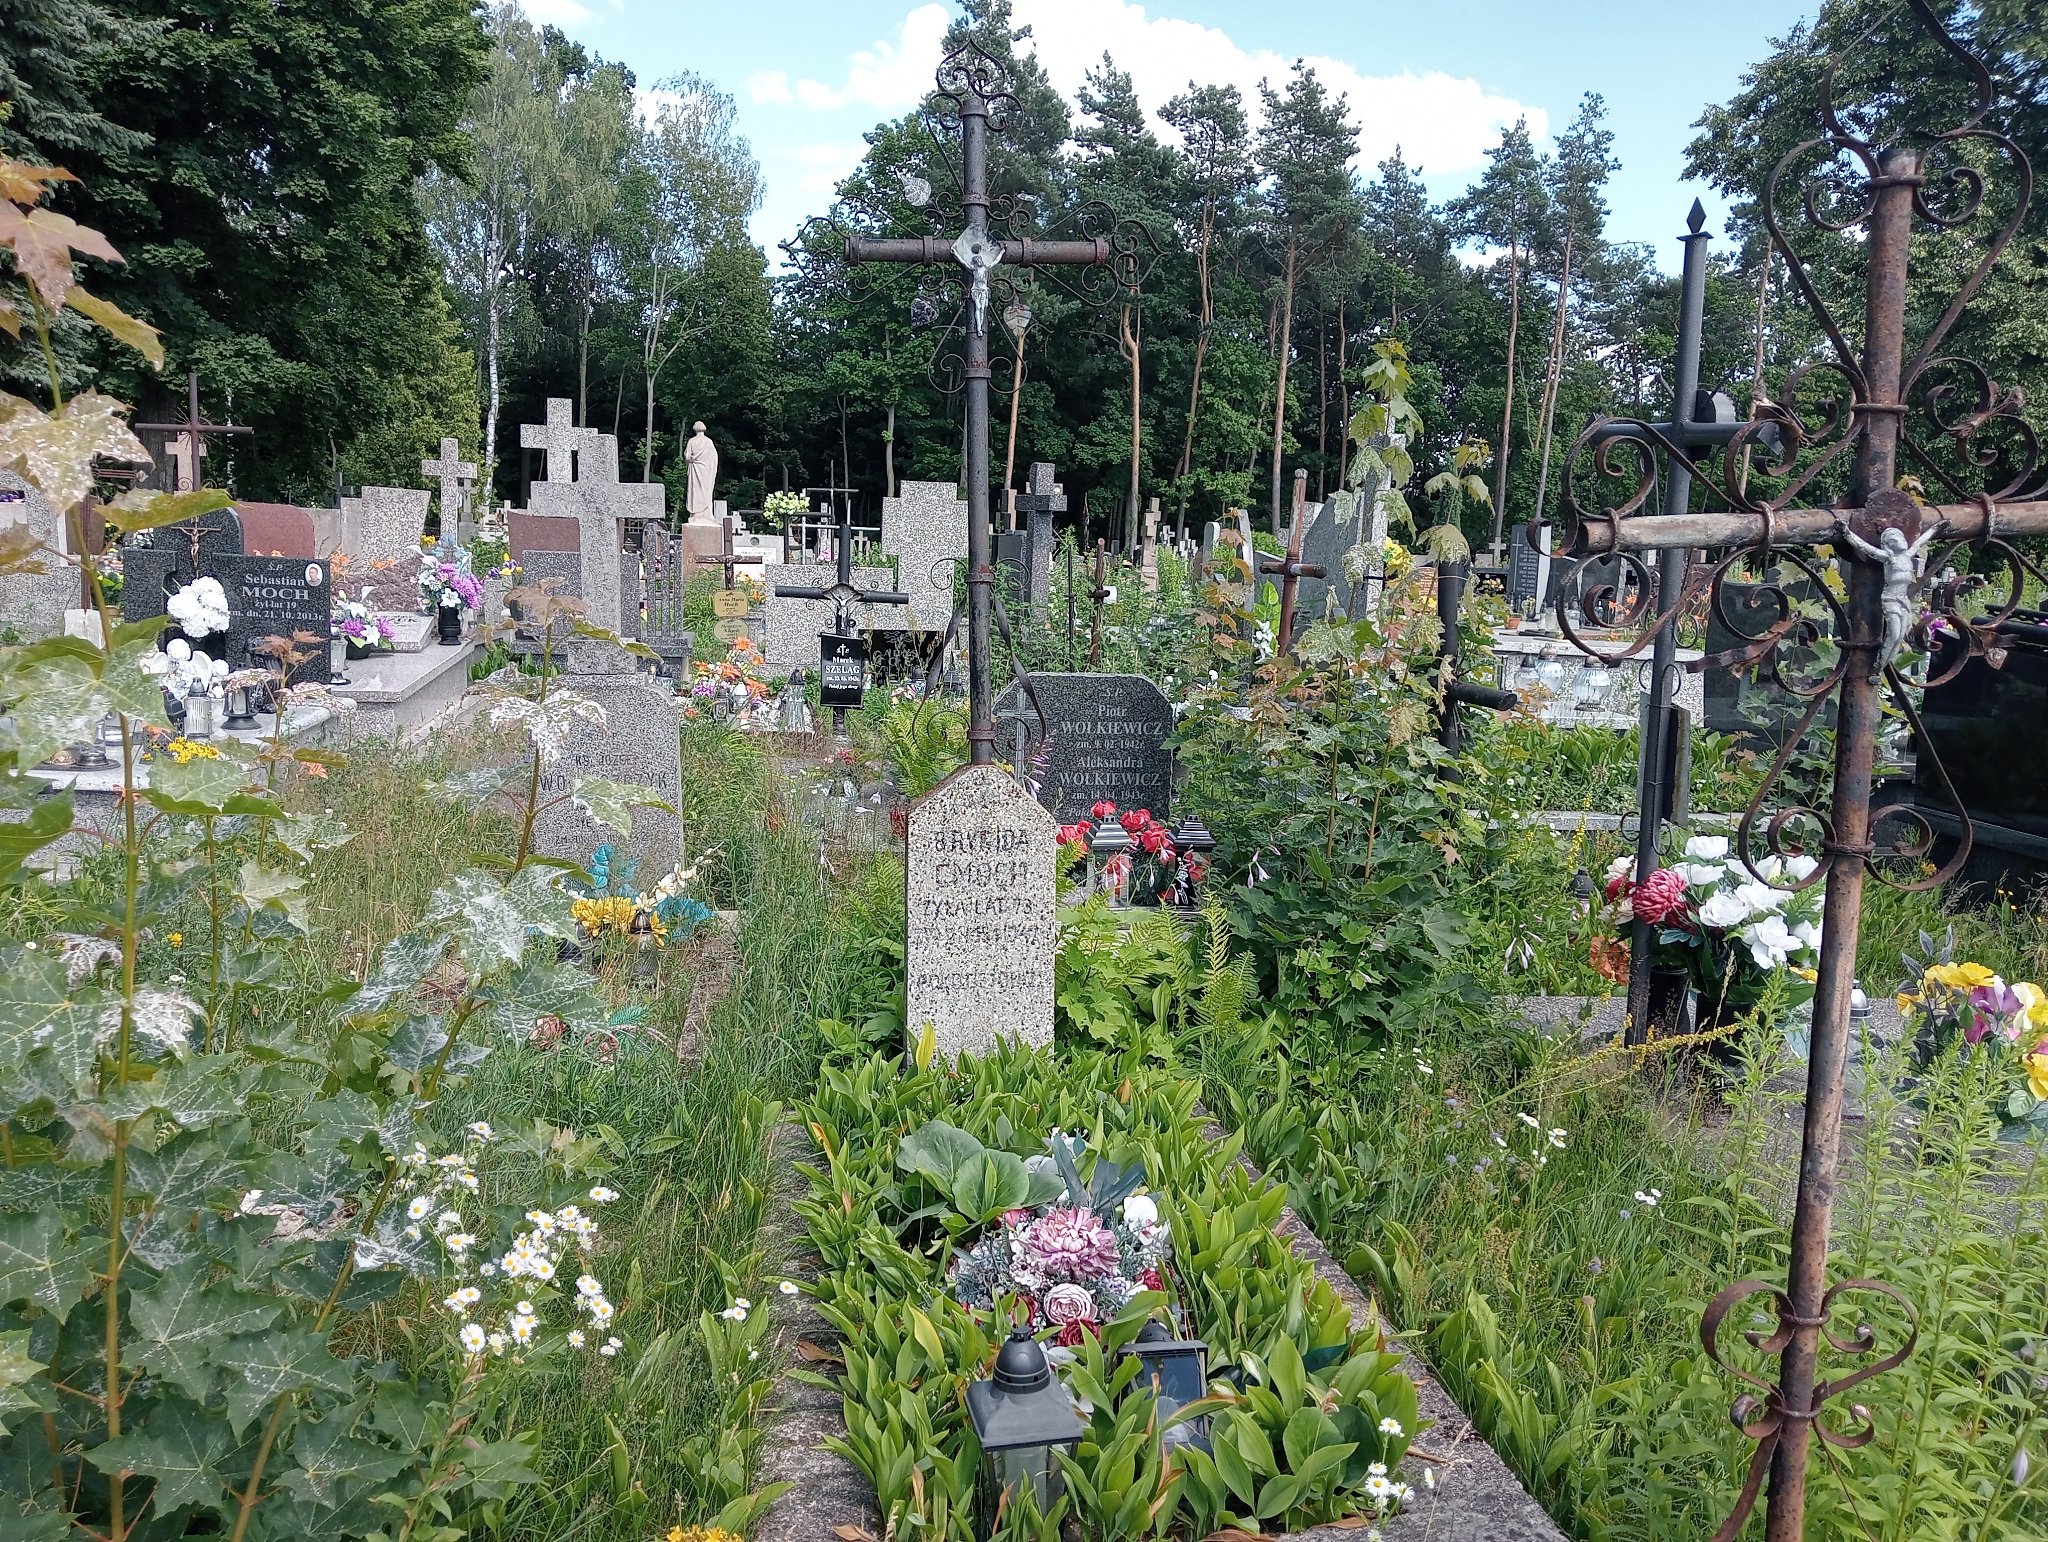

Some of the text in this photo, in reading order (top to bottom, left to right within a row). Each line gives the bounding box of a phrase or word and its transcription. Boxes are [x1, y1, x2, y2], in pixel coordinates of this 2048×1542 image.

[245, 573, 305, 587] Sebastian
[241, 585, 309, 600] MOCH
[286, 601, 297, 609] 19
[230, 609, 244, 617] m.
[246, 609, 262, 618] dn.
[264, 610, 278, 619] 21.
[281, 611, 294, 619] 10.
[832, 656, 854, 664] Marek
[825, 665, 860, 675] SZELĄG
[1098, 704, 1128, 717] Piotr
[1077, 756, 1144, 768] Aleksandra
